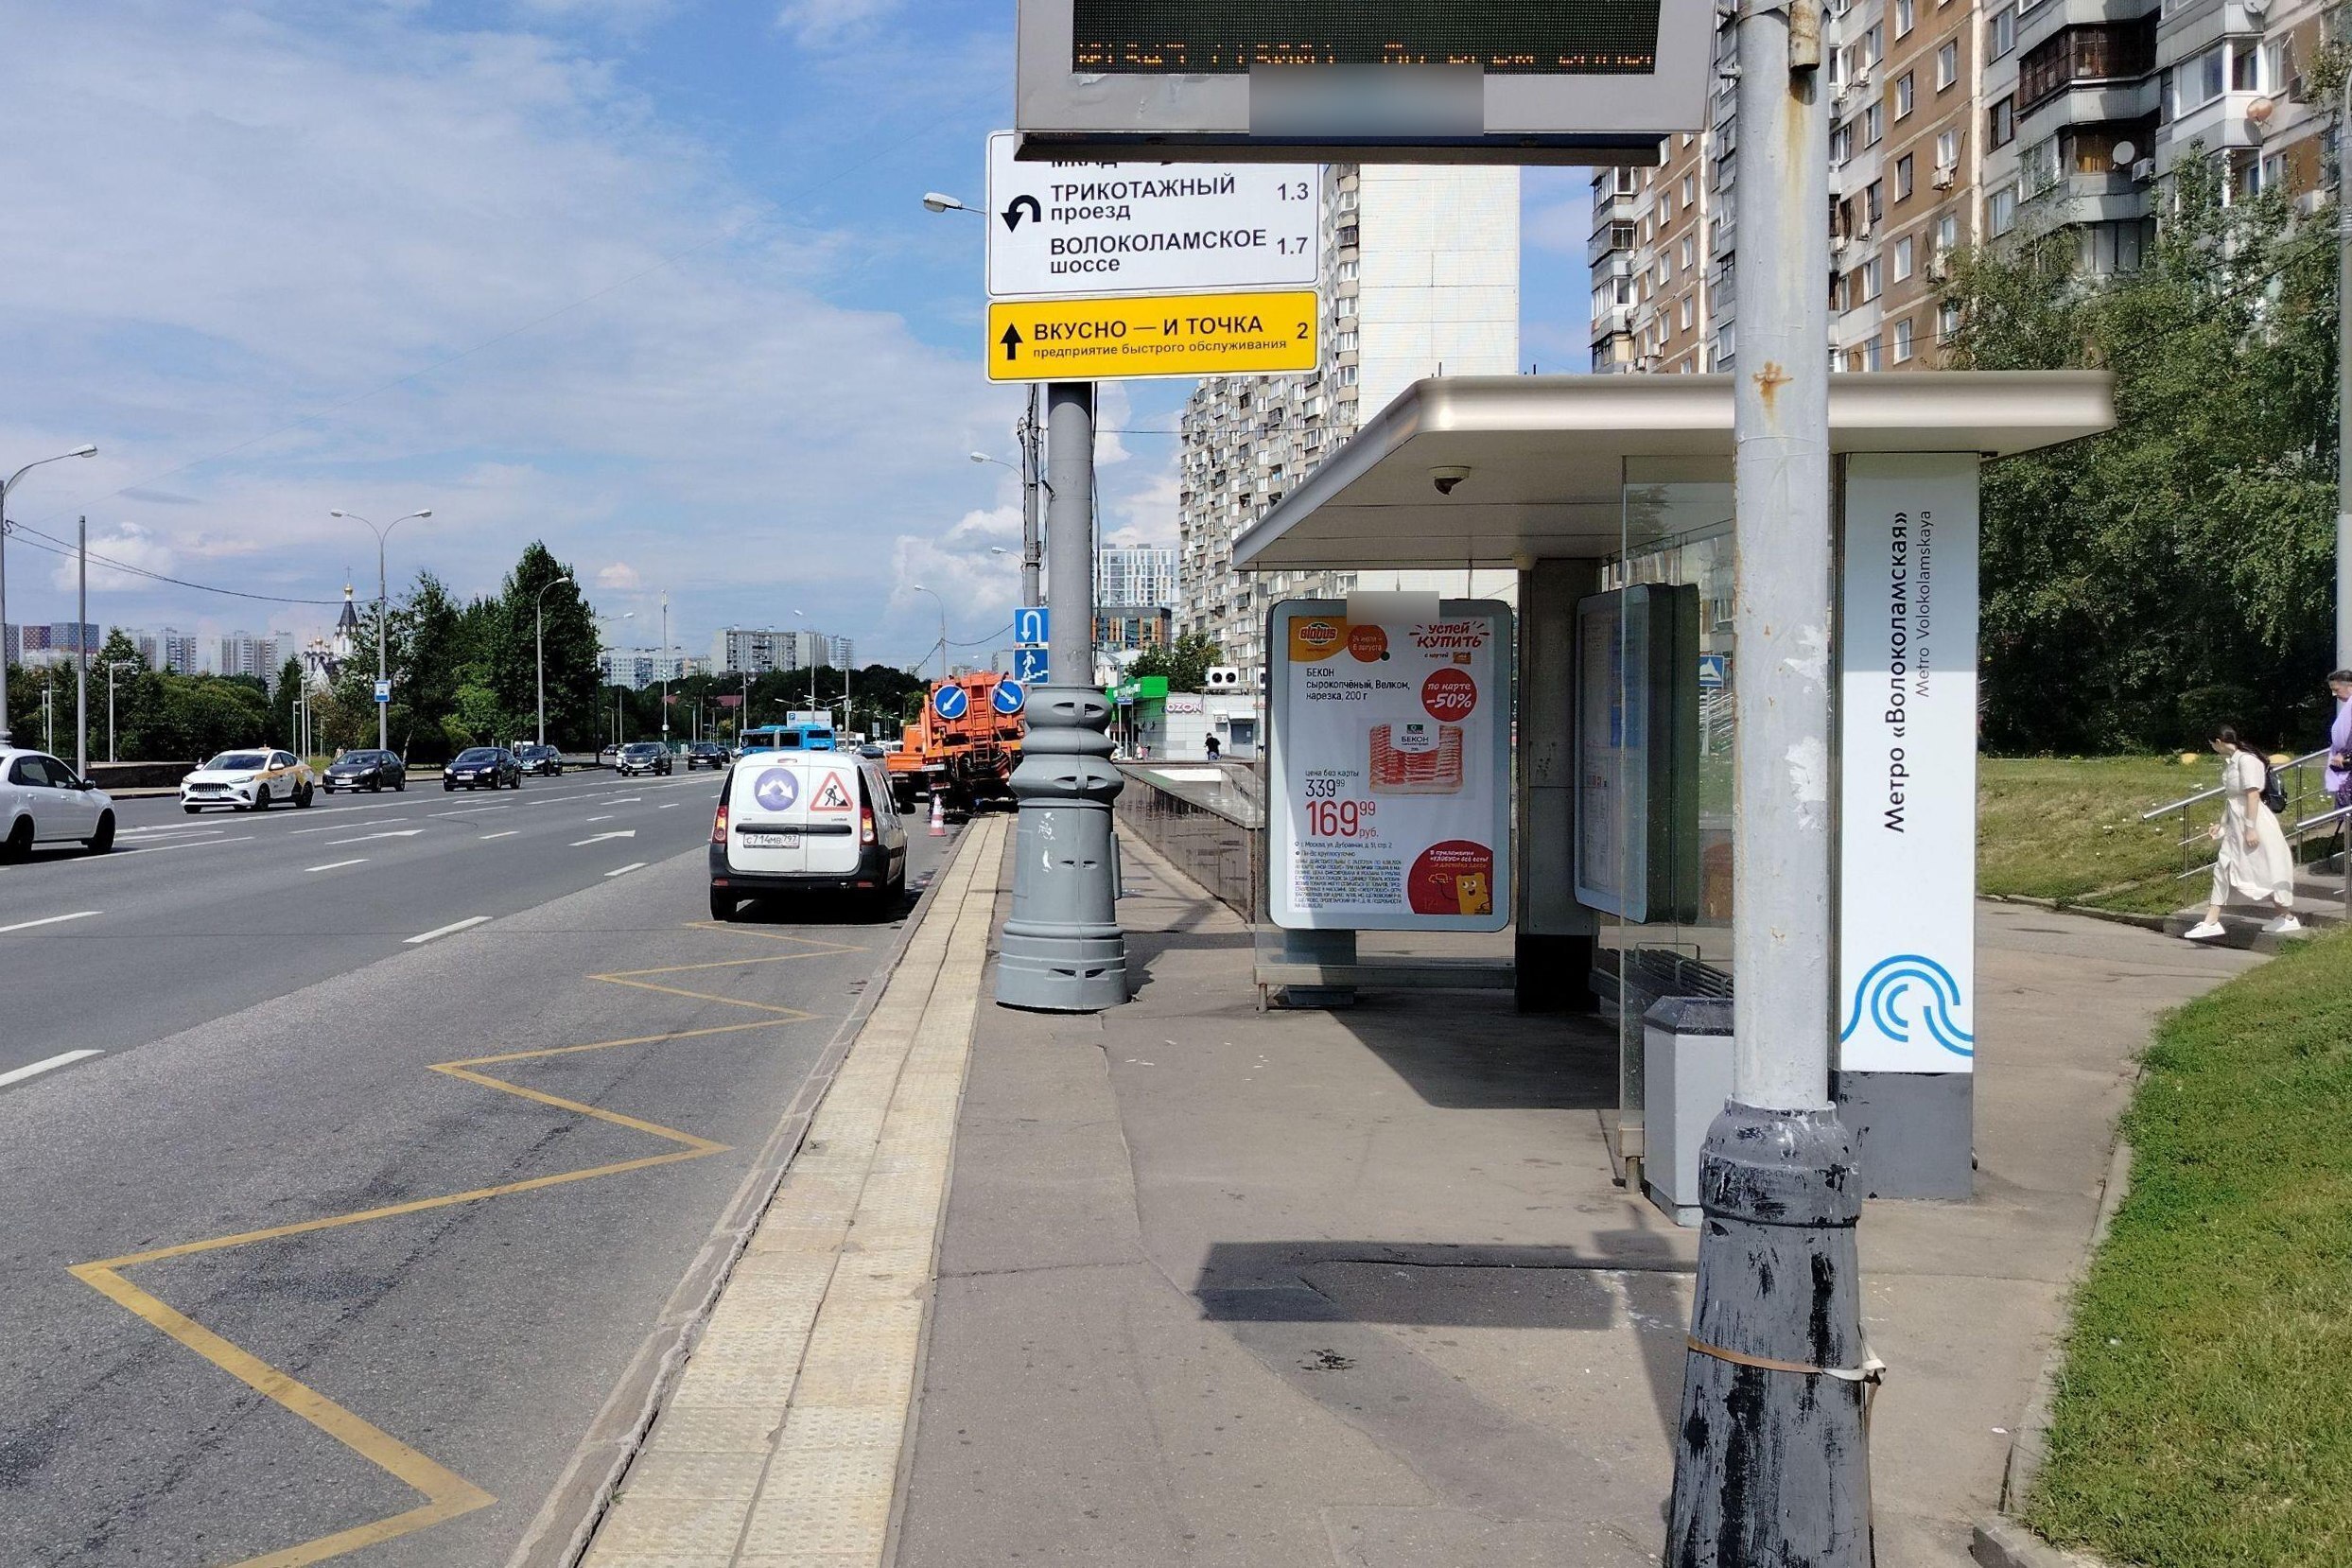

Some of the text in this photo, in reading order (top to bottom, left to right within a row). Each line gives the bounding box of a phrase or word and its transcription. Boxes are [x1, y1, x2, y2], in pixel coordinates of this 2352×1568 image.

[1051, 172, 1235, 201] ТРИКОТАЖНЫЙ
[1277, 183, 1309, 200] 1.3
[1051, 204, 1131, 224] проезд
[1051, 229, 1266, 255] ВОЛОКОЛАМСКОЕ
[1277, 236, 1309, 255] 1.7
[1051, 258, 1121, 274] шоссе
[1034, 320, 1126, 340] ВКУСНО
[1163, 319, 1178, 336] И
[1186, 315, 1263, 335] ТОЧКА
[1297, 322, 1309, 340] 2
[1034, 340, 1287, 358] предприятие быстрого обслуживания
[1915, 511, 1932, 698] Metro Volokolamskaya
[1418, 636, 1482, 649] КУПИТЬ
[1306, 668, 1334, 677] БЕКОН
[1884, 511, 1909, 833] Метро «Волоколамская»
[1306, 680, 1410, 690] сырокопчёный, Велком,
[1442, 683, 1472, 691] карте
[1306, 692, 1343, 701] нарезка,
[1345, 691, 1362, 700] 200
[1426, 693, 1472, 708] -50%
[1166, 703, 1202, 714] OZON
[1359, 827, 1379, 839] руб.
